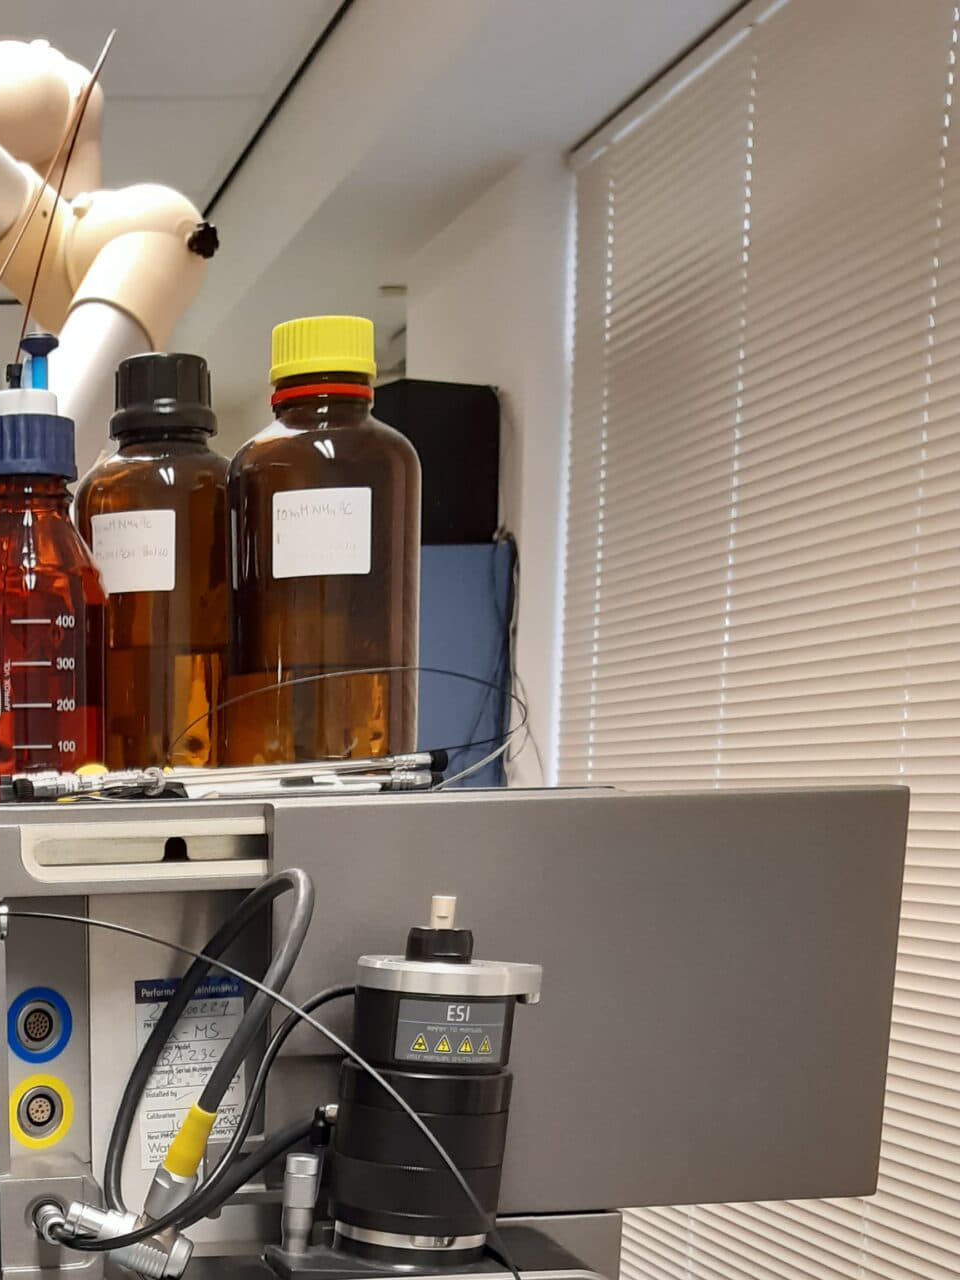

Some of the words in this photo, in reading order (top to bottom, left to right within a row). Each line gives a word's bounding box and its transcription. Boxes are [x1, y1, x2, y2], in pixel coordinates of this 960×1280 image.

[55, 615, 76, 628] 400
[56, 657, 76, 670] 300
[56, 698, 76, 712] 200
[57, 740, 76, 753] 100
[446, 1004, 471, 1022] ESI
[147, 1142, 170, 1154] Wat
